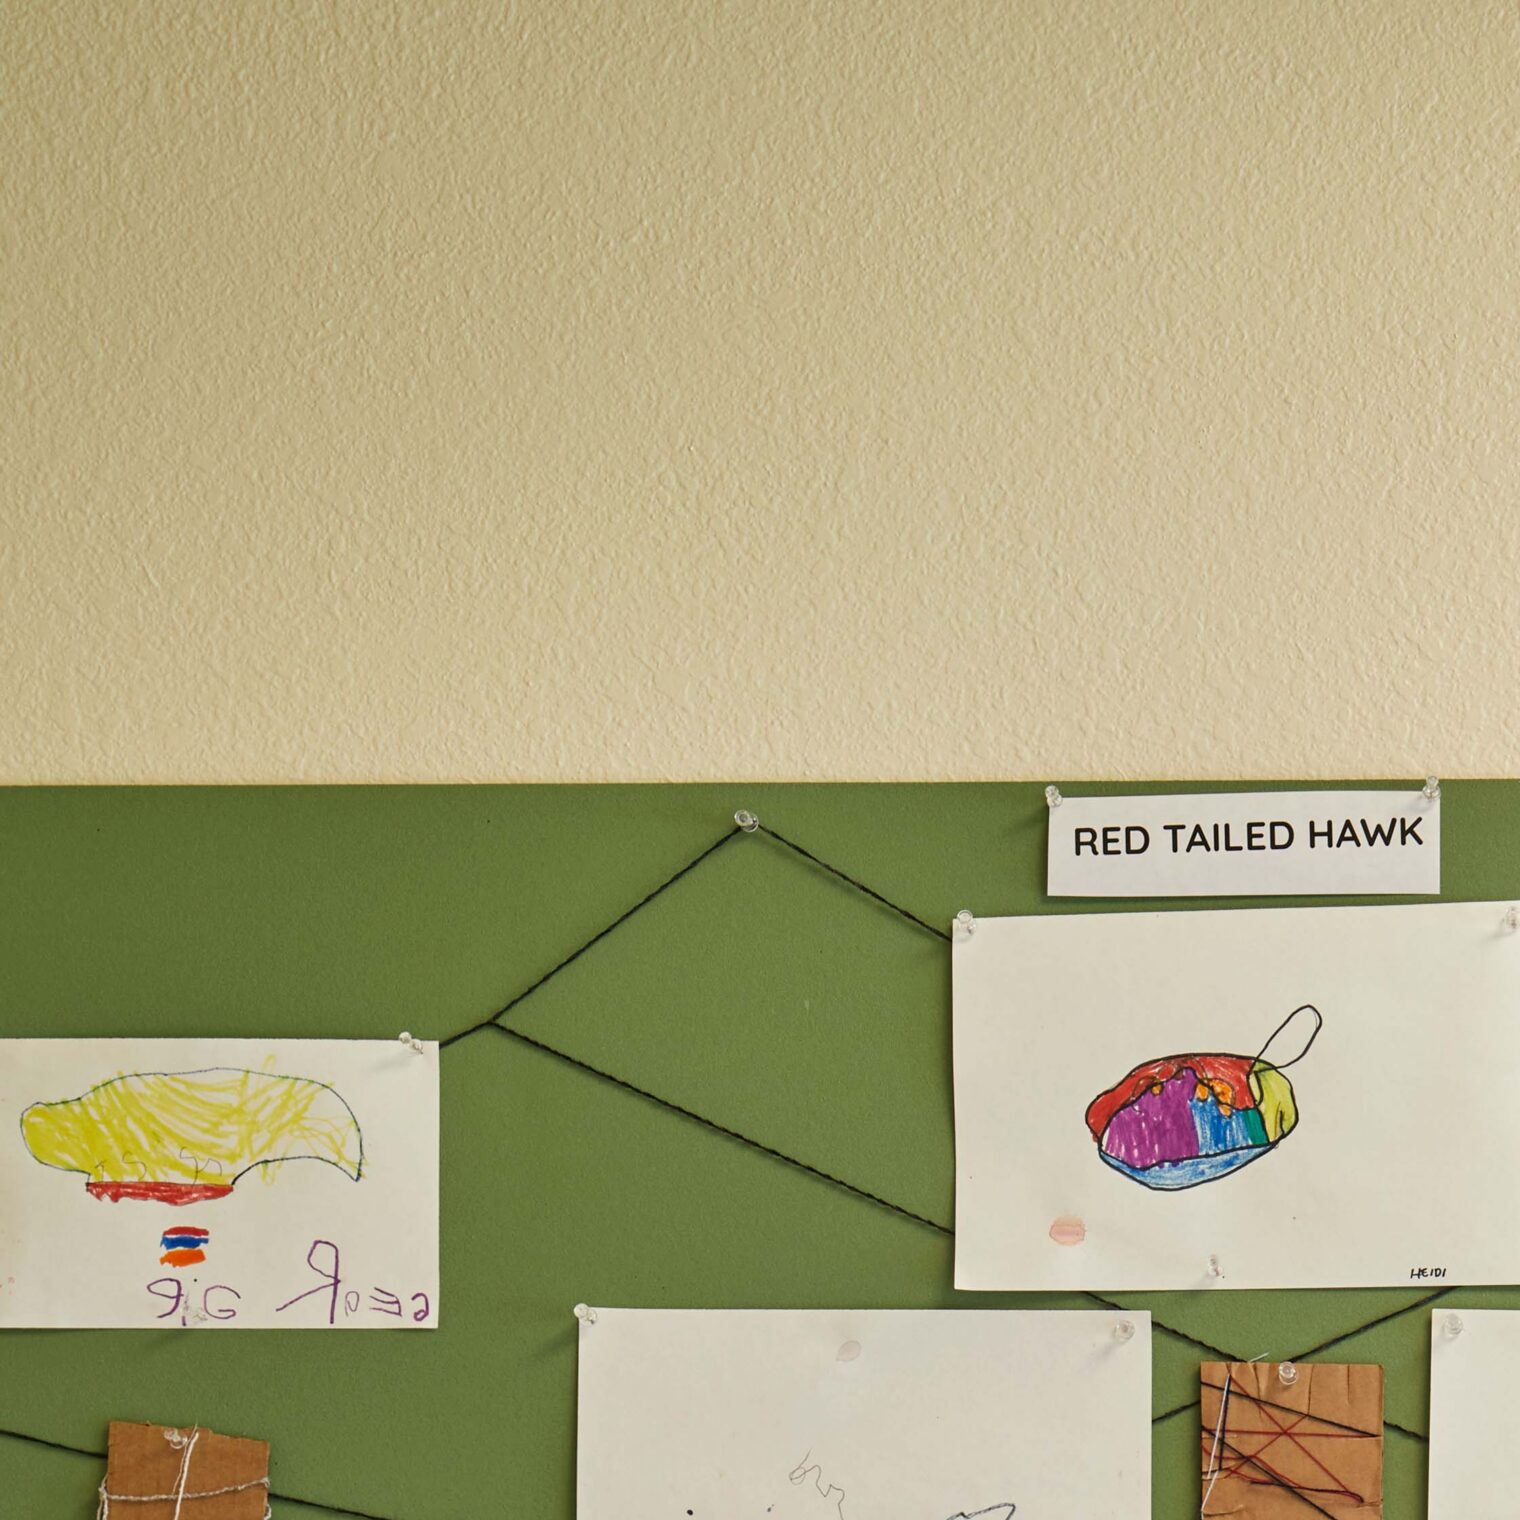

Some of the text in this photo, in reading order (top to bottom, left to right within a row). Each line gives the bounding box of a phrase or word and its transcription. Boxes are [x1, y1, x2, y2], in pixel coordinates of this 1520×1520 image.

[1074, 816, 1424, 856] RED TAILED HAWK
[1409, 1267, 1447, 1280] HEIDI
